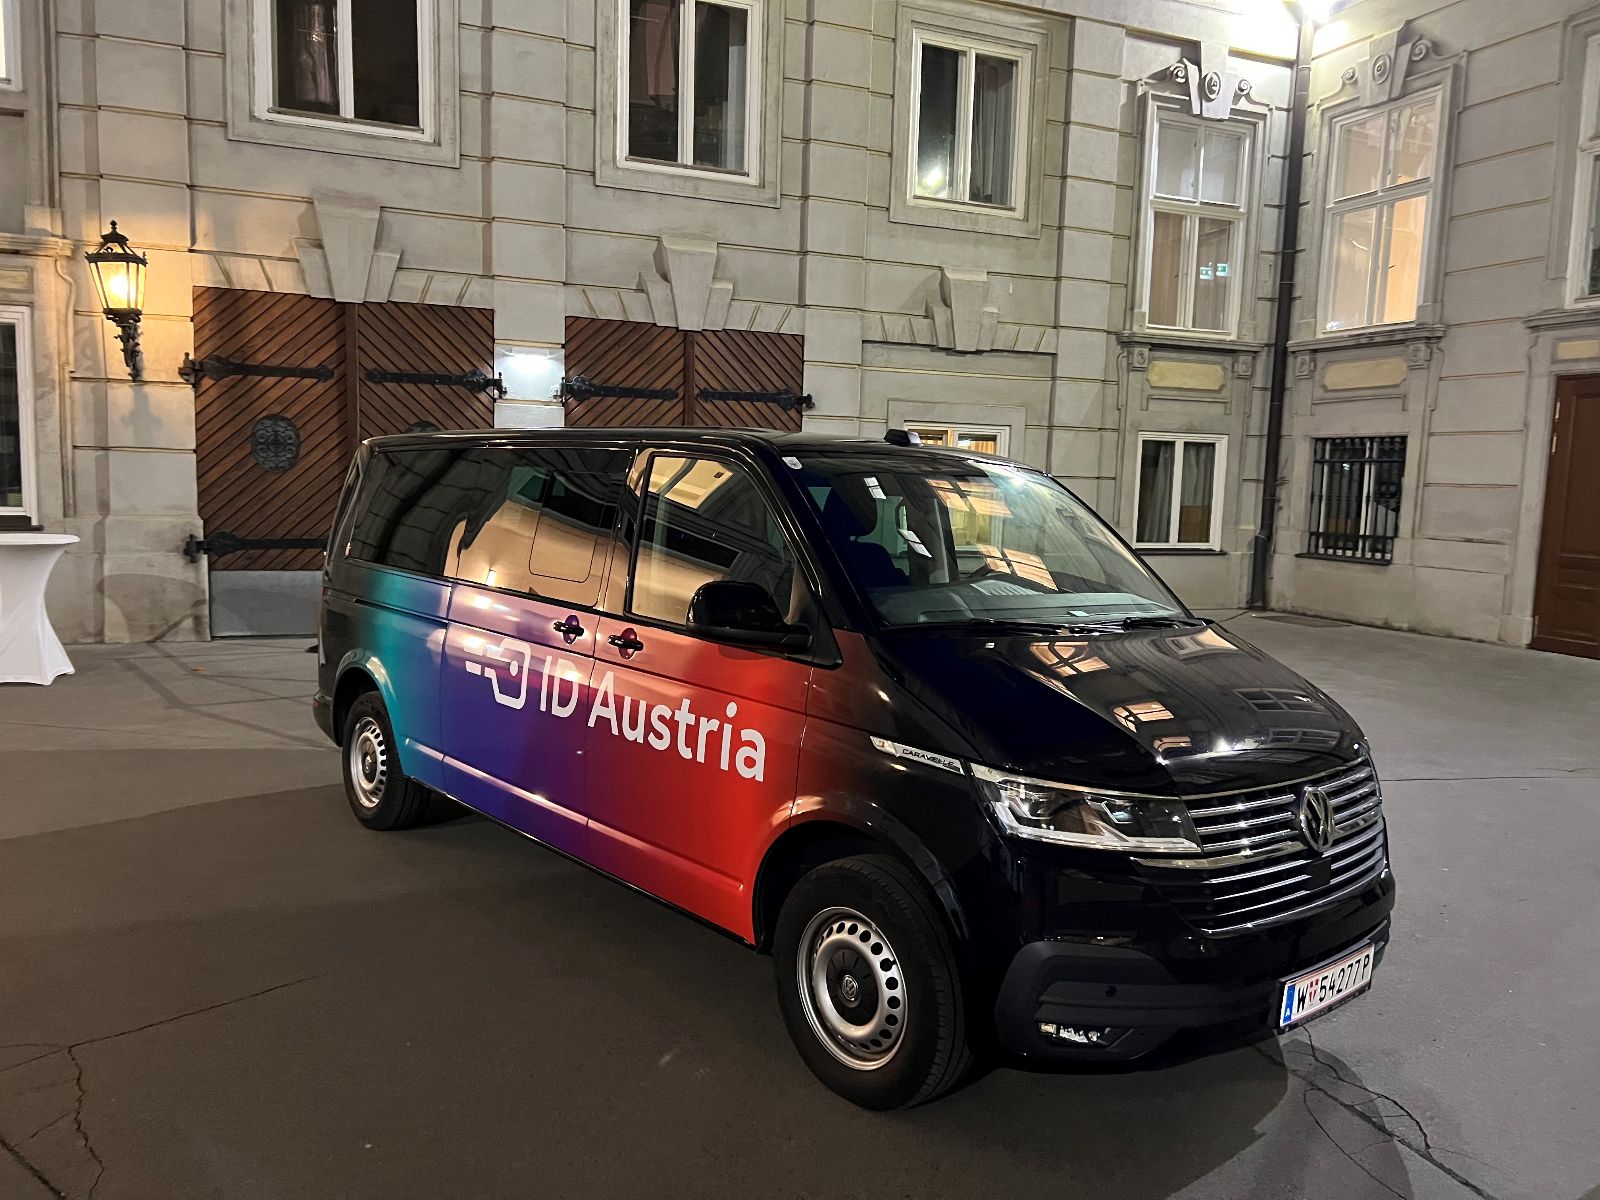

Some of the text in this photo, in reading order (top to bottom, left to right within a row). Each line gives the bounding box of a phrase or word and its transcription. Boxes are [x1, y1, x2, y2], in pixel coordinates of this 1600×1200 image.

[540, 655, 766, 782] ID Austria
[1296, 983, 1309, 1014] W
